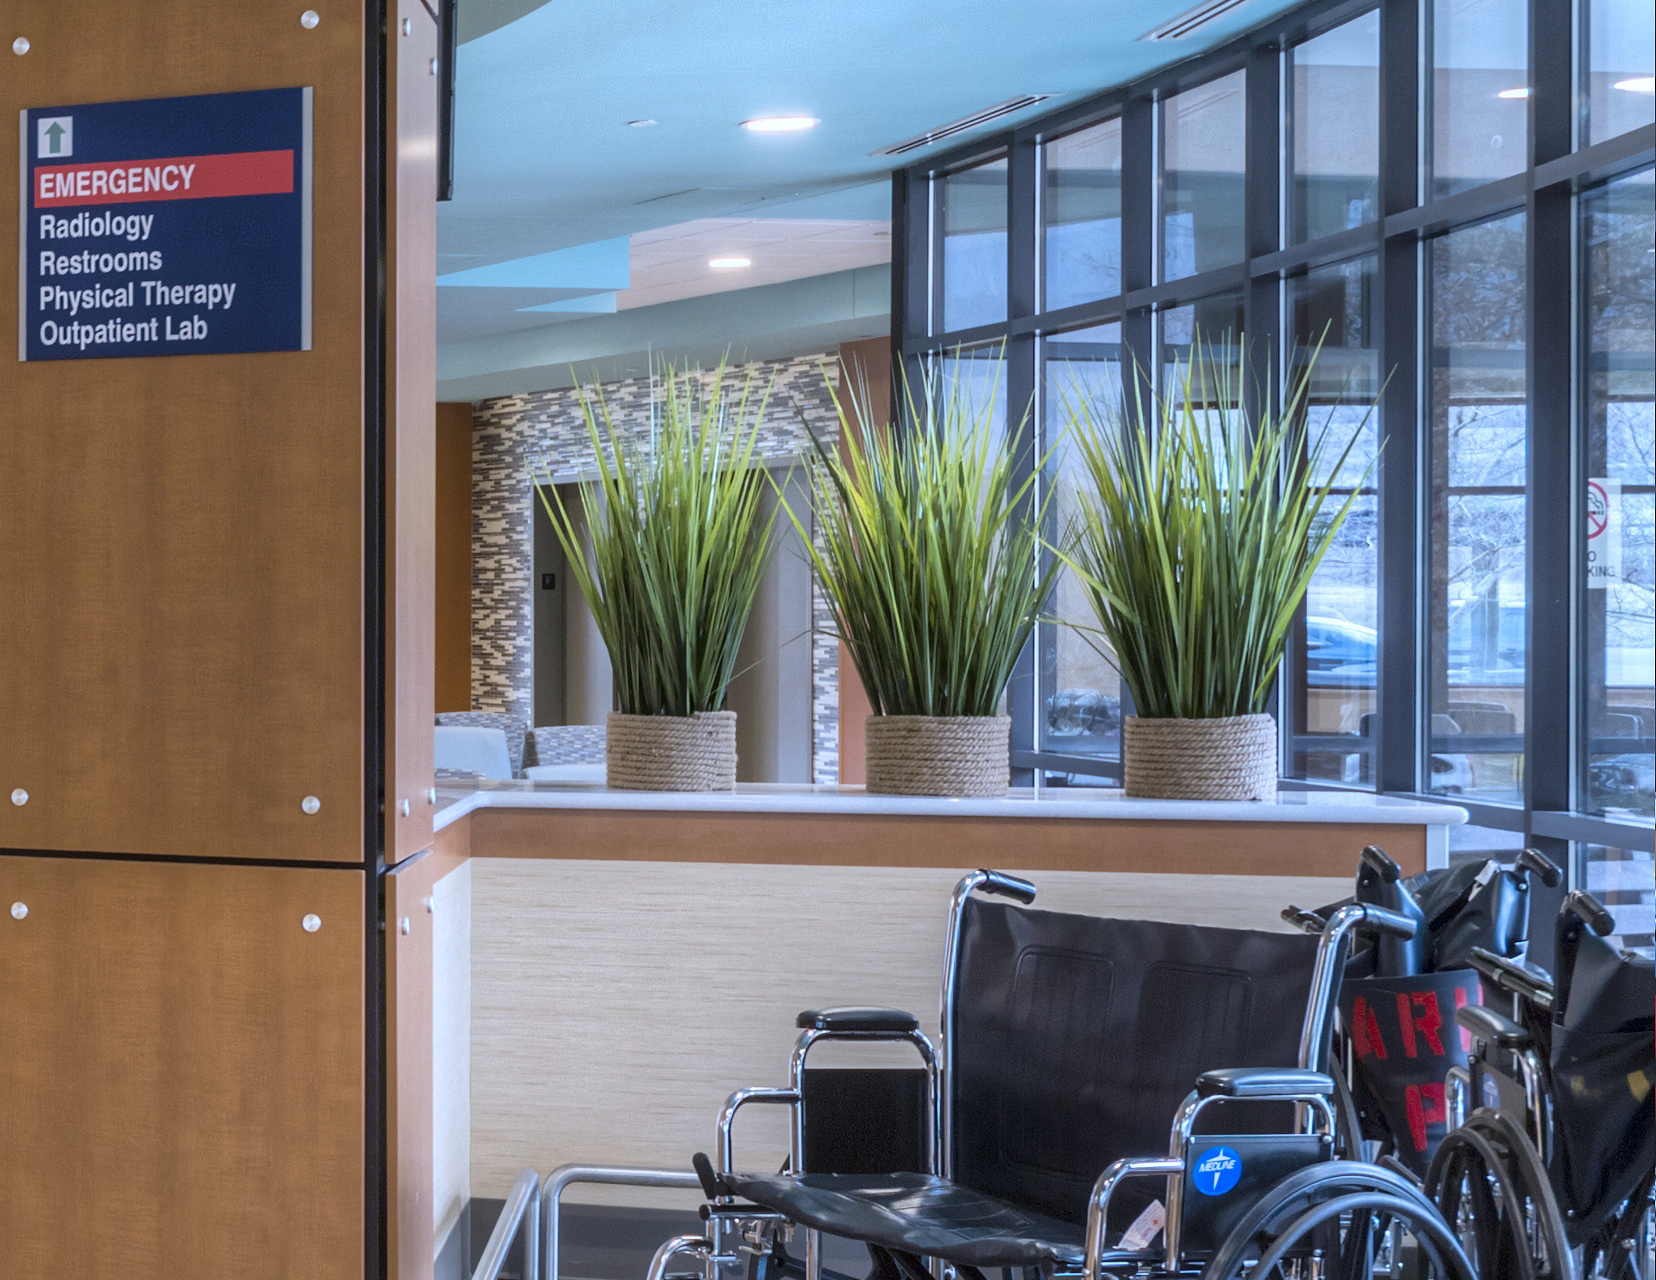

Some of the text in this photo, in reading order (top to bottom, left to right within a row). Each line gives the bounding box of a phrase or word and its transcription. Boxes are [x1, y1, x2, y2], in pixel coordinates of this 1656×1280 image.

[39, 164, 196, 199] EMERGENCY
[39, 211, 154, 241] Radiology
[39, 250, 163, 276] Restrooms
[39, 280, 237, 315] Physical Therapy
[39, 314, 208, 350] Outpatient Lab
[1587, 550, 1597, 562] O
[1587, 565, 1615, 577] KING
[1198, 1159, 1237, 1173] MEDLINE
